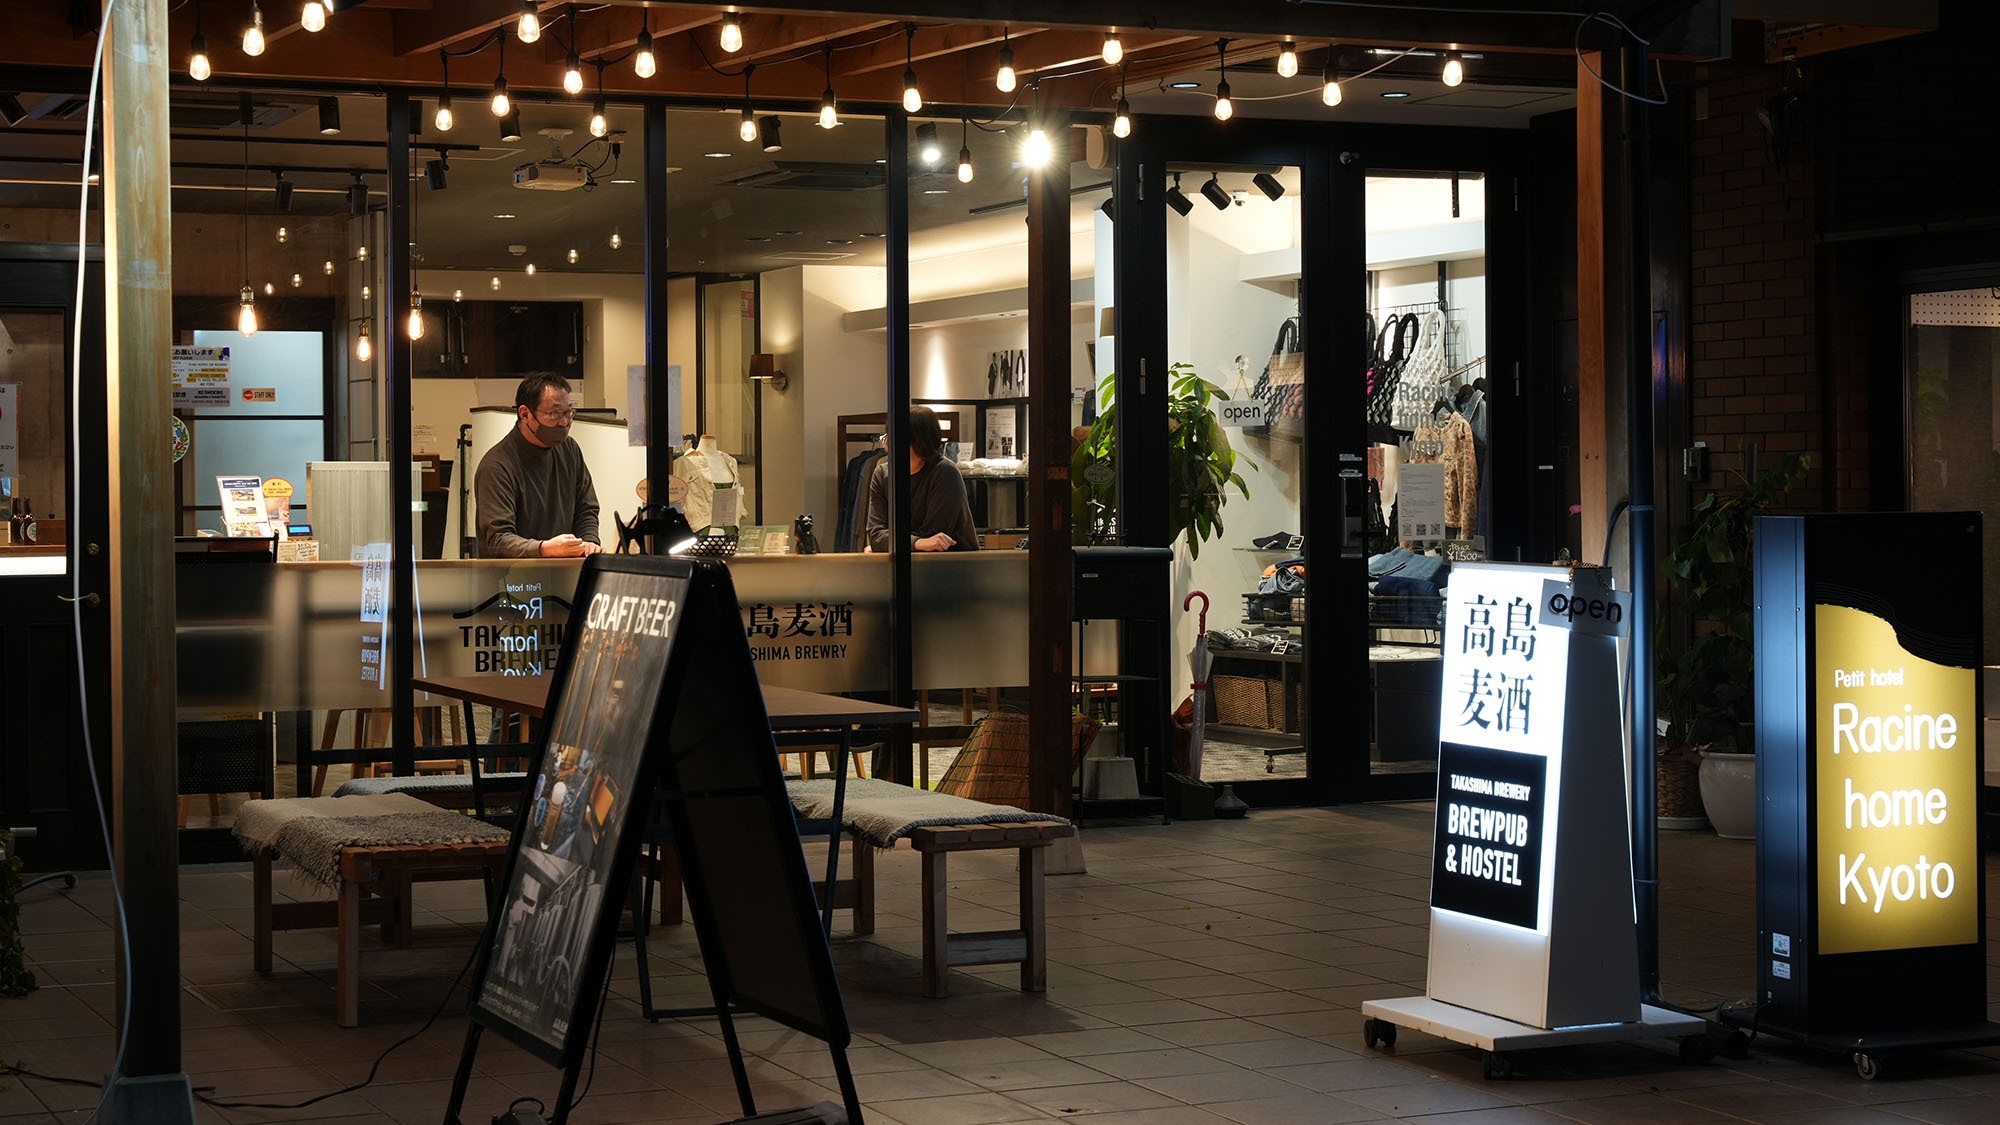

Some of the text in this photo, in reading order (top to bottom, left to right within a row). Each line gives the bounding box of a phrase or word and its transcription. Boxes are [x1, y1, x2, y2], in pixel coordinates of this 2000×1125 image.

[254, 391, 265, 399] STAFF
[1223, 404, 1261, 424] open
[587, 592, 639, 633] CRAFT
[634, 598, 676, 638] BEER
[745, 601, 853, 639] 島麦酒
[1550, 593, 1622, 622] open
[459, 623, 567, 648] TAKASHI
[1461, 594, 1537, 662] 高島
[475, 649, 557, 673] BREWE
[750, 644, 847, 661] SHIMA BREWRY
[1835, 667, 1904, 688] Petit hotel
[1458, 667, 1534, 735] 麦酒
[1832, 702, 1957, 754] Racine
[1451, 774, 1531, 801] TAKASHIMA BREWERY
[1845, 778, 1947, 829] home
[1448, 803, 1528, 847] BREWPUB
[1445, 844, 1522, 886] & HOSTEL
[1839, 853, 1955, 913] Kyoto
